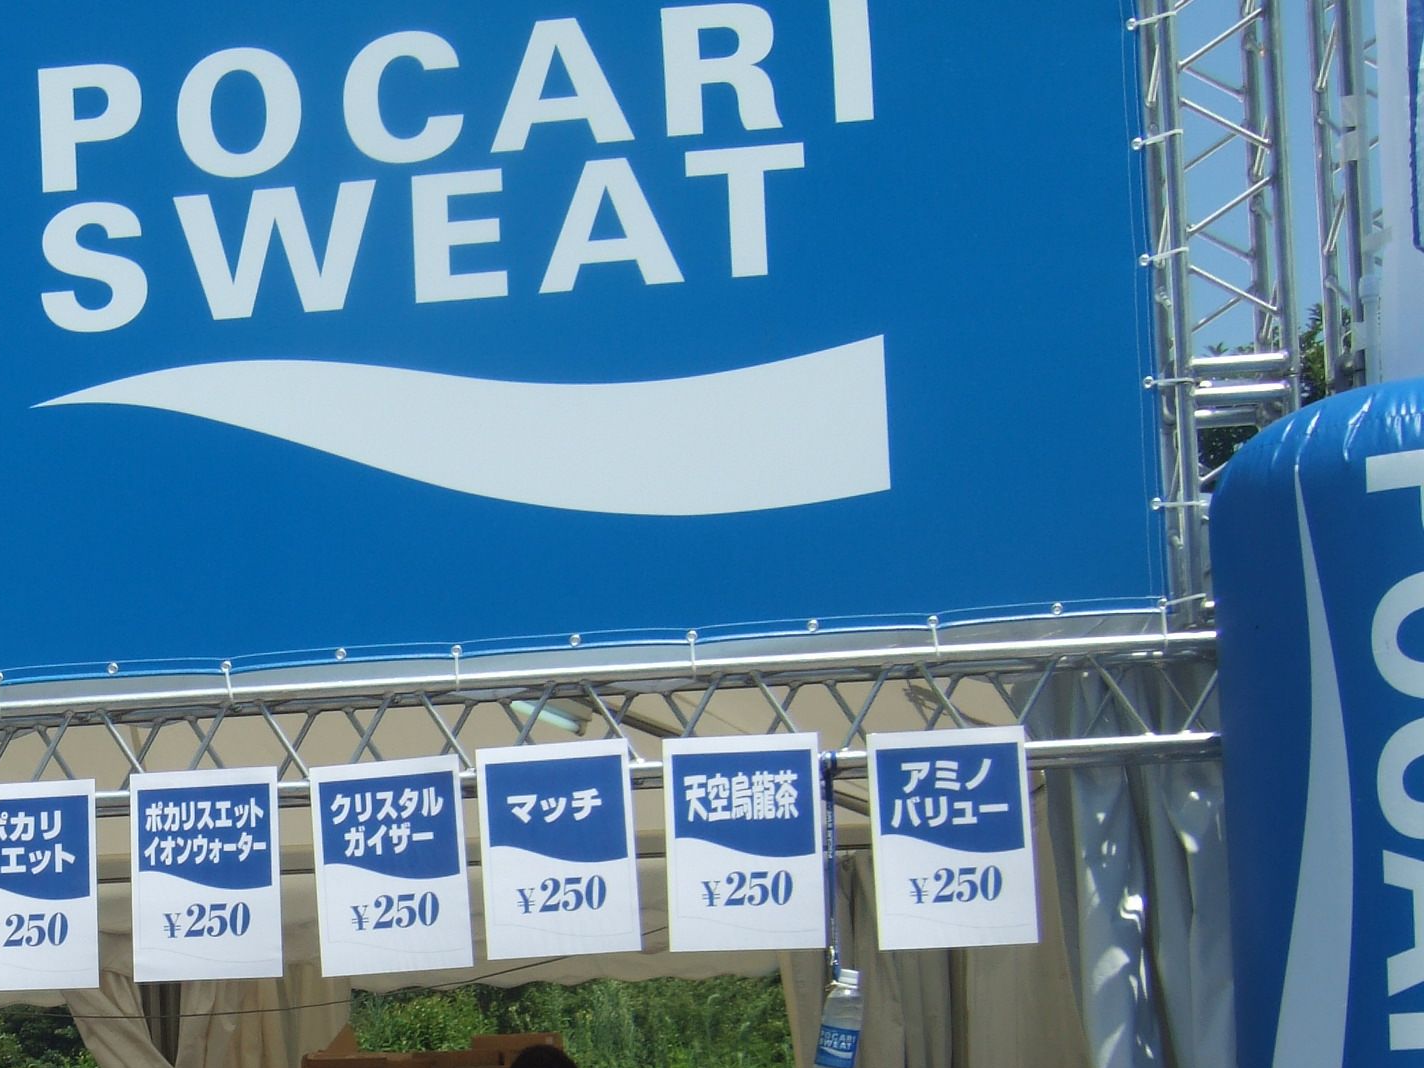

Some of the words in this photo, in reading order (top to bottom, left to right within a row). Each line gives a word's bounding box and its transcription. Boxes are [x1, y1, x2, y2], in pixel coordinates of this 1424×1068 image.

[37, 0, 875, 193] POCARI
[40, 142, 806, 334] SWEAT
[900, 758, 993, 794] アミノ
[144, 797, 265, 834] ポカリスエット
[330, 787, 444, 826] クリスタル
[506, 788, 603, 824] マッチ
[683, 770, 799, 823] 天空烏龍茶
[891, 796, 1009, 829] バリュー
[144, 832, 266, 867] イオンウォーター
[344, 821, 434, 858] ガイザー
[517, 874, 608, 915] ¥250
[701, 869, 794, 908] ¥250
[908, 865, 1003, 905] ¥250
[163, 901, 251, 939] ¥250
[350, 891, 440, 931] ¥250
